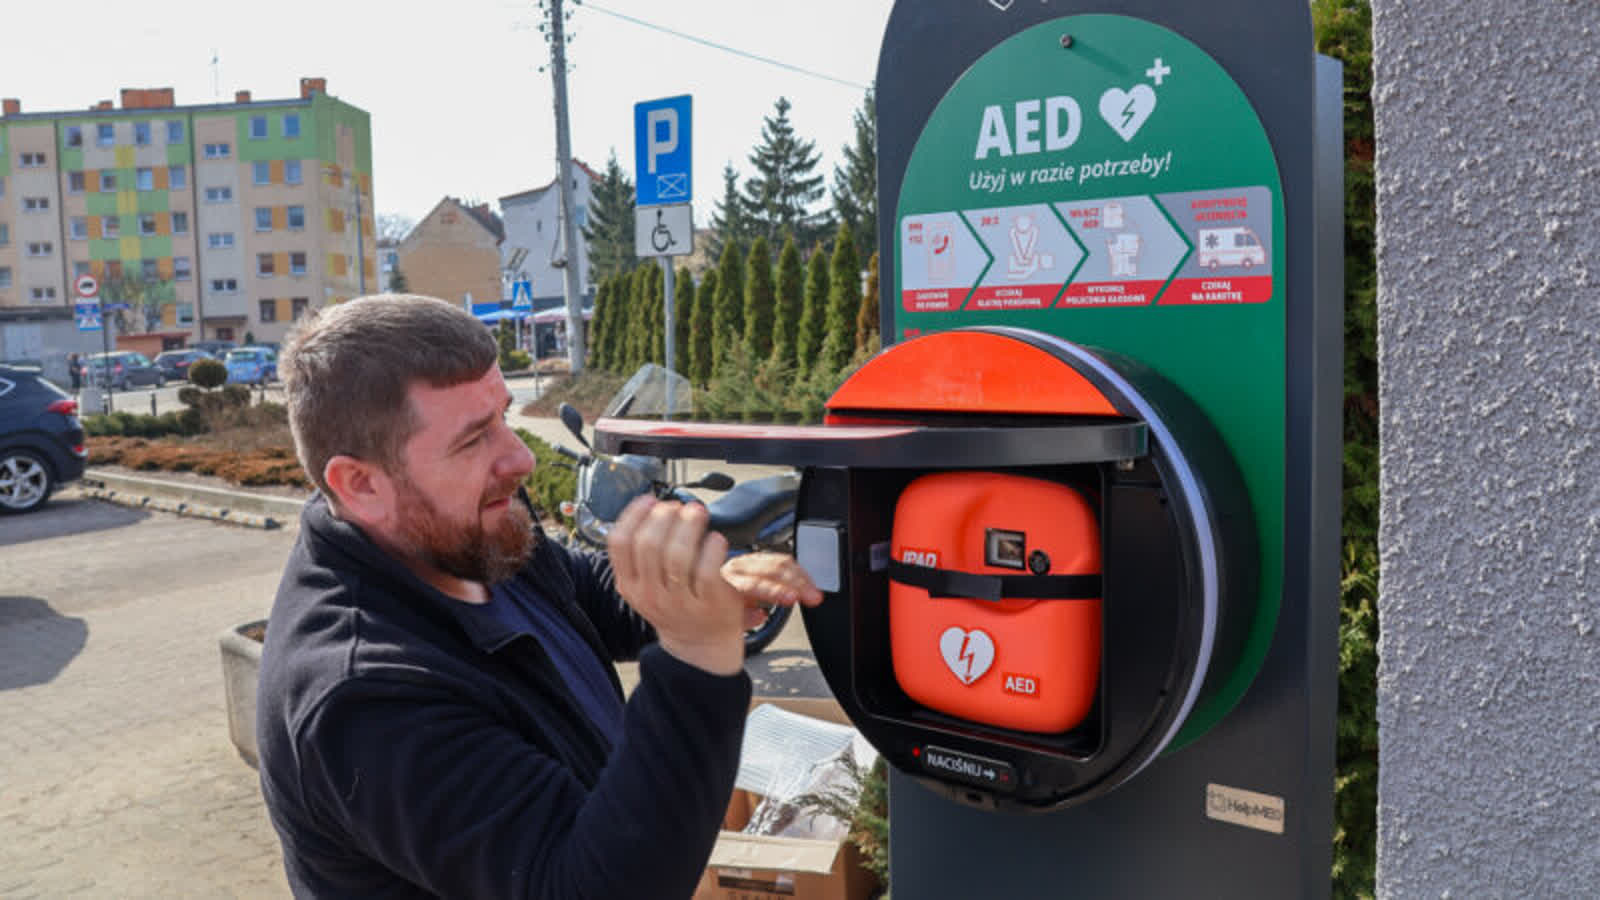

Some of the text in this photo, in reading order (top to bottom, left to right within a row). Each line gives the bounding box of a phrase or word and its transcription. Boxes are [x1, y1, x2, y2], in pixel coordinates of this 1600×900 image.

[647, 108, 679, 175] P
[974, 95, 1083, 160] AED
[968, 150, 1173, 193] Użyj w razie potrzeby!
[903, 550, 937, 568] IPAD
[1005, 676, 1036, 694] AED
